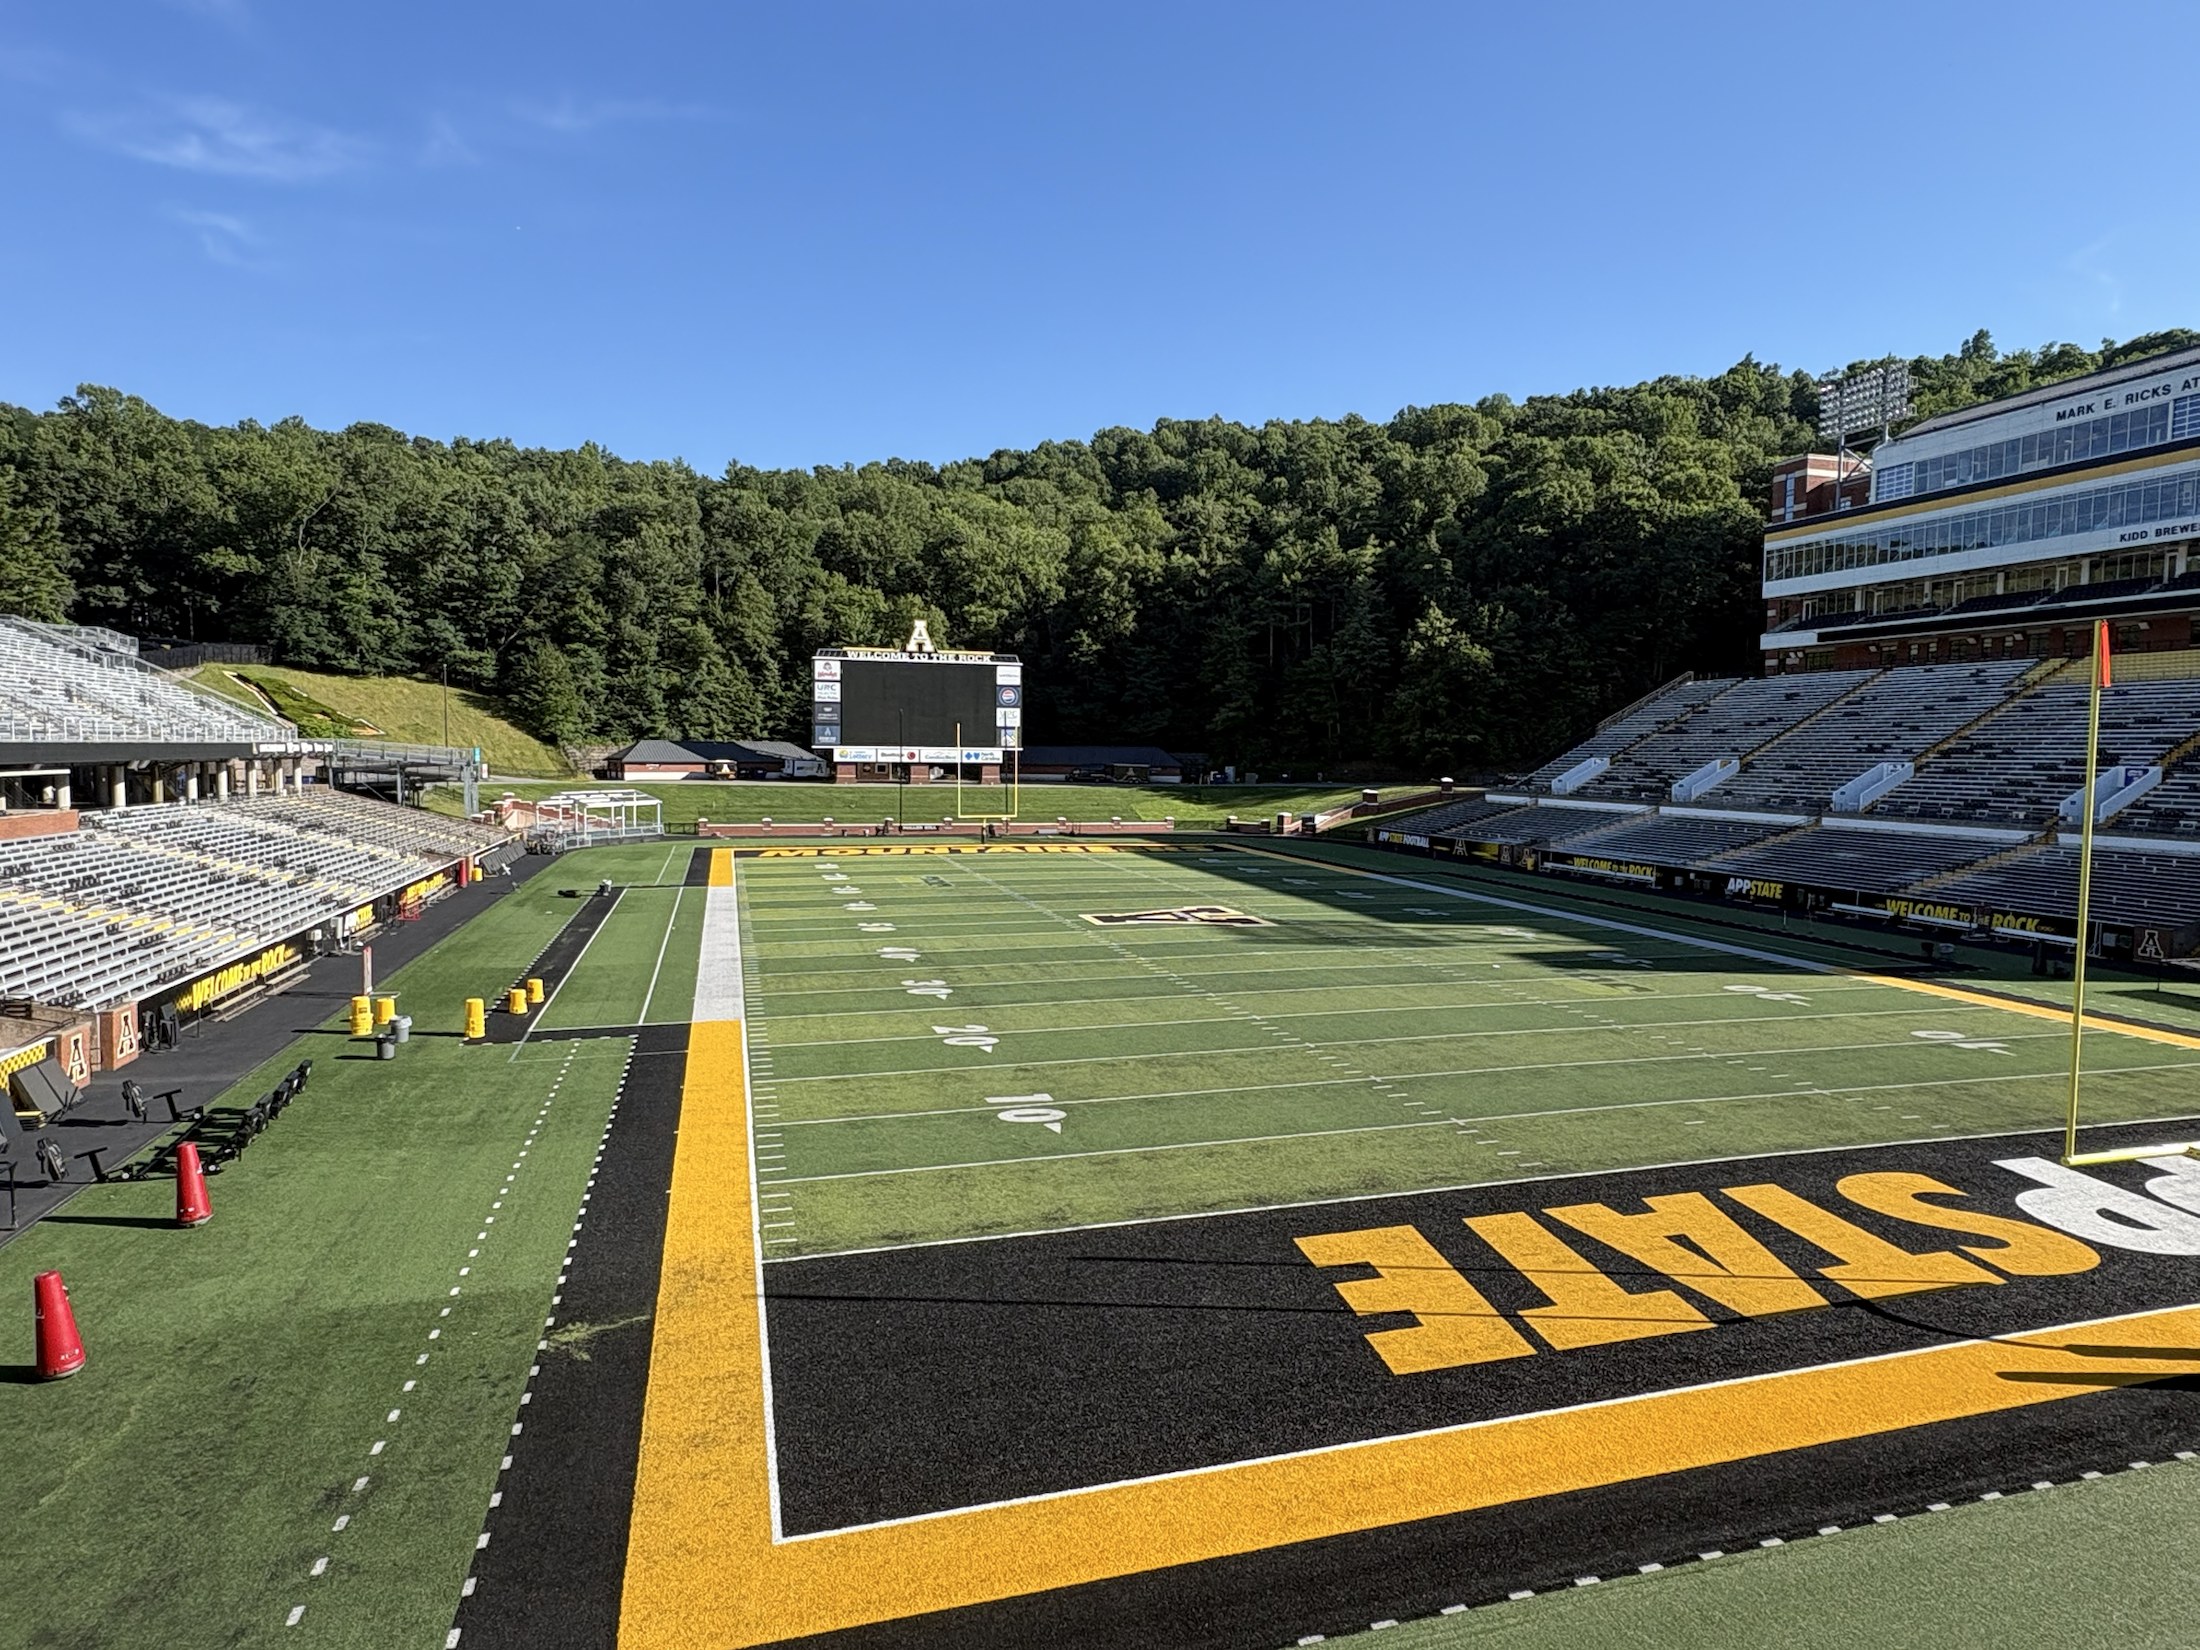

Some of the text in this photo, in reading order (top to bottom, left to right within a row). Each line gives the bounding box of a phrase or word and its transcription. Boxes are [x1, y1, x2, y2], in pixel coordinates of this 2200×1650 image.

[2056, 402, 2095, 422] MARK
[2104, 398, 2116, 410] E.
[2125, 384, 2171, 406] RICKS
[2120, 523, 2200, 542] KIDD BREWE
[905, 620, 935, 652] A
[847, 651, 992, 663] WELCOME TO THE ROCK
[1573, 857, 1612, 871] WELCOME
[1628, 865, 1654, 877] ROCK
[1885, 899, 1959, 921] WELCOME
[1991, 912, 2040, 931] ROCK
[192, 963, 244, 1011] WELCOME
[261, 944, 285, 974] ROCK
[984, 1093, 1068, 1123] 10
